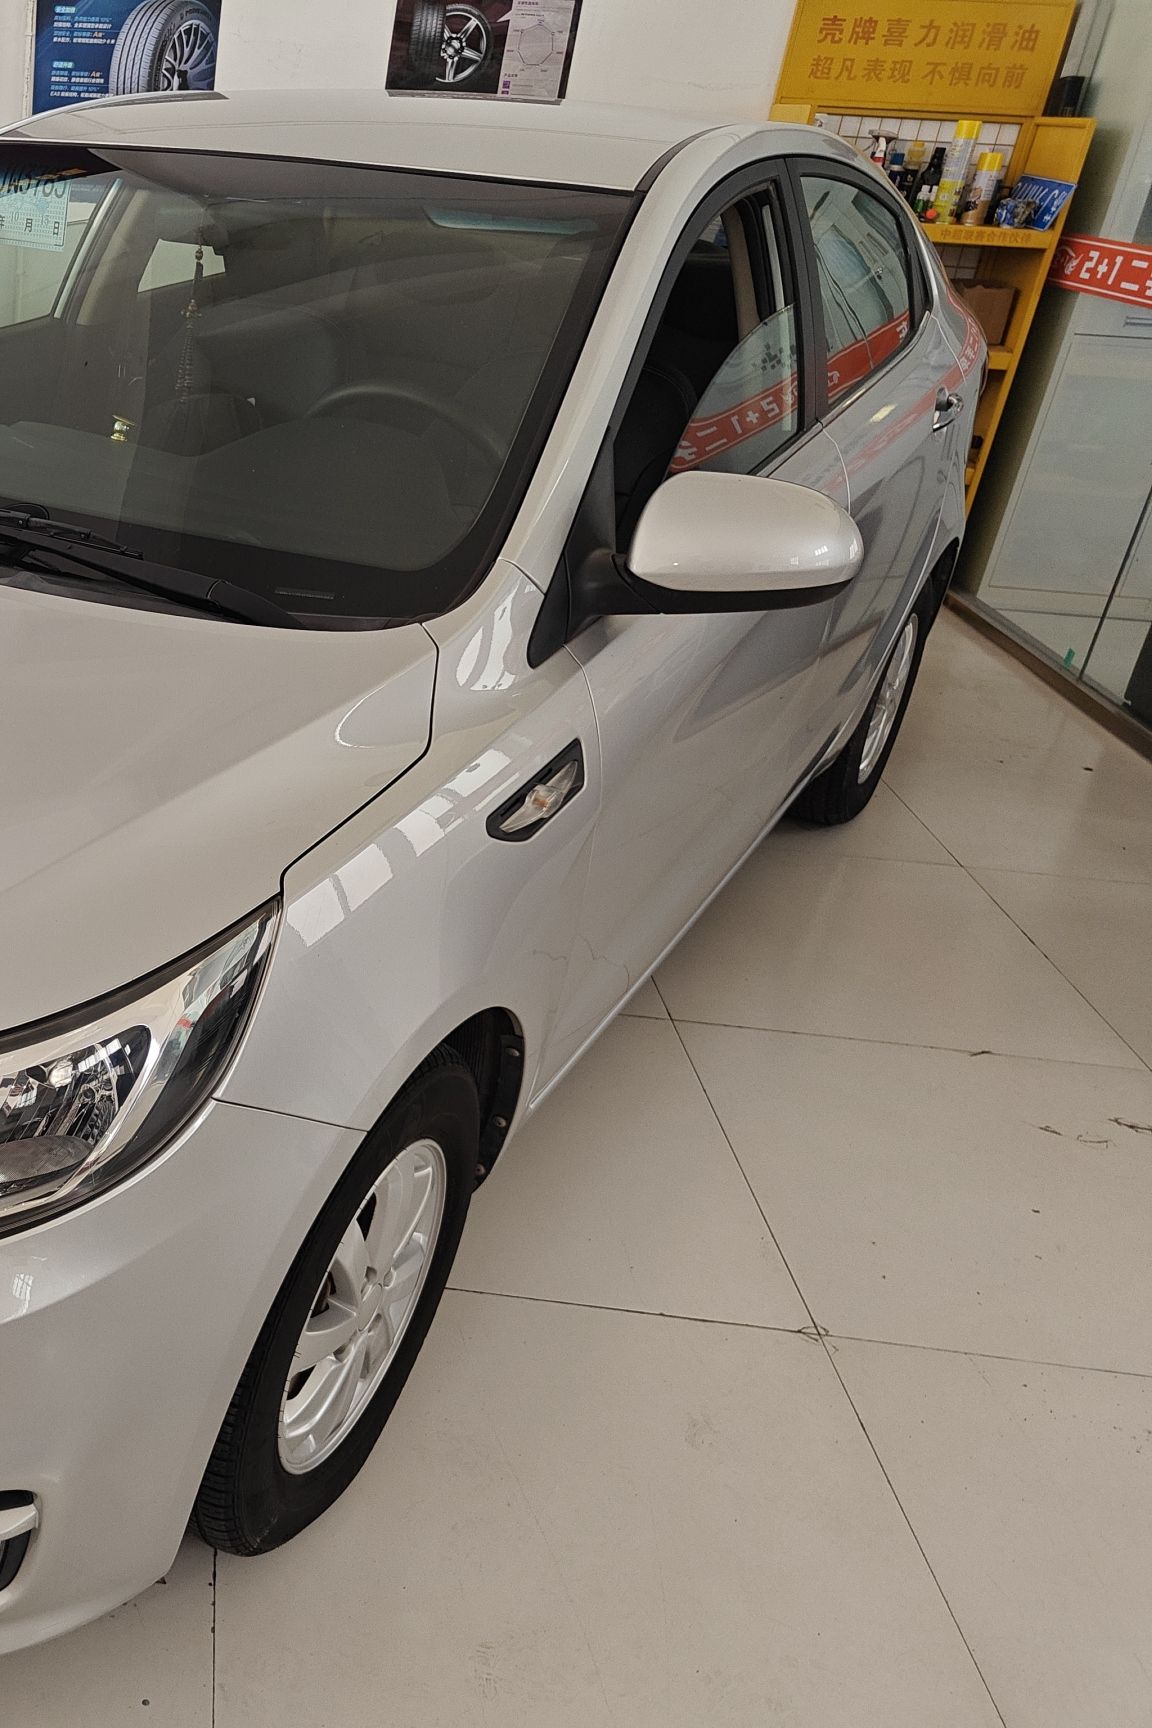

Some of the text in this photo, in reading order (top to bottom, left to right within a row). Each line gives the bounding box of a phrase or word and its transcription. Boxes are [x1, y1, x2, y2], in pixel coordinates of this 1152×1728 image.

[817, 15, 1041, 53] 壳牌喜力润滑油
[808, 54, 1028, 90] 超凡表现 不惧向前
